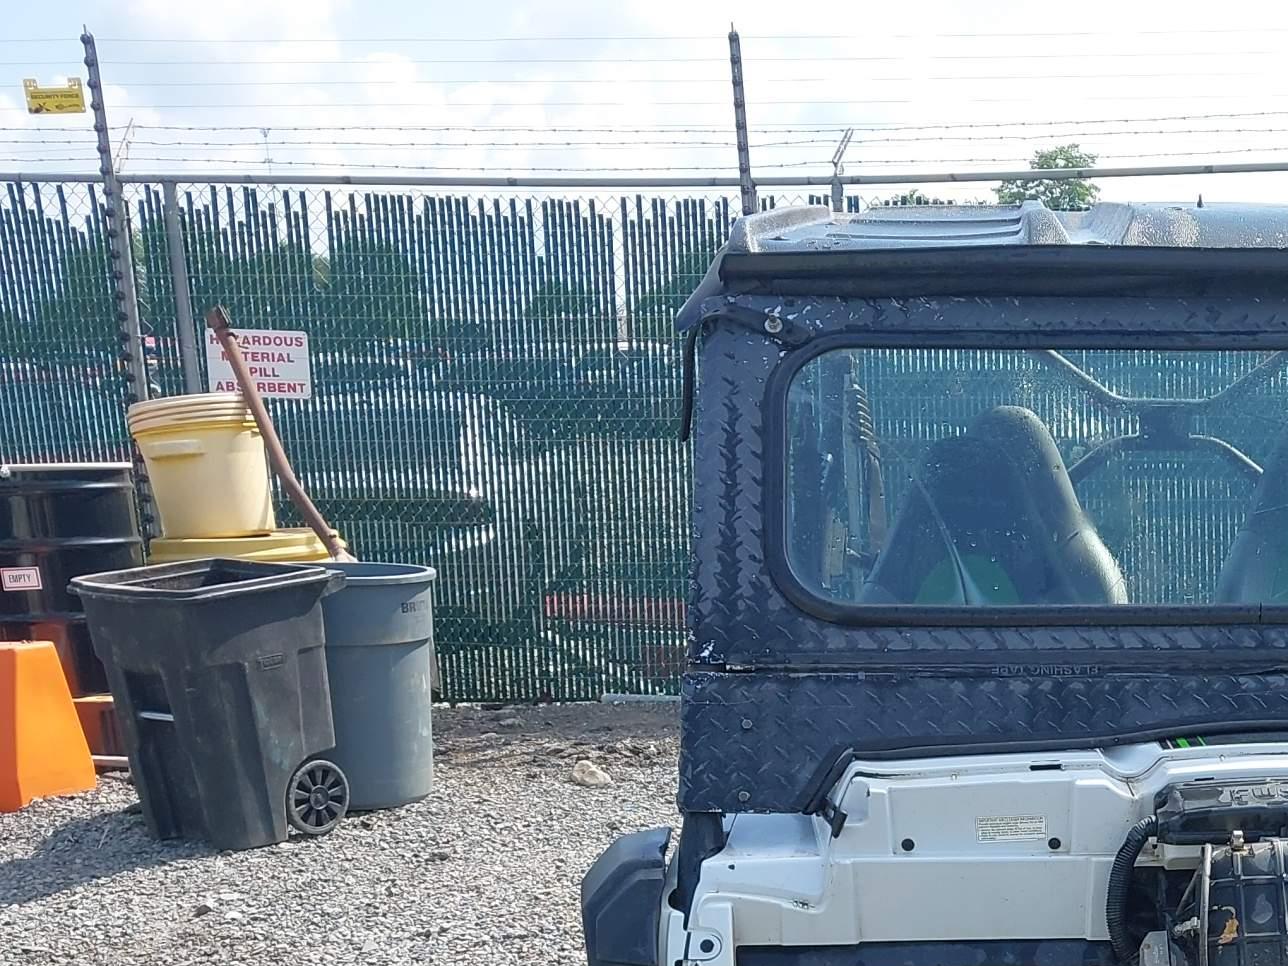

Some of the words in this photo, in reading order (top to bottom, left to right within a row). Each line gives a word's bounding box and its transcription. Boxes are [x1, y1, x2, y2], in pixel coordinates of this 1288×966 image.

[210, 334, 303, 347] HARDOUS
[221, 350, 295, 363] MTERIAL
[243, 366, 280, 378] PILL
[216, 380, 306, 393] ABSRBENT
[8, 574, 31, 583] EMPTY
